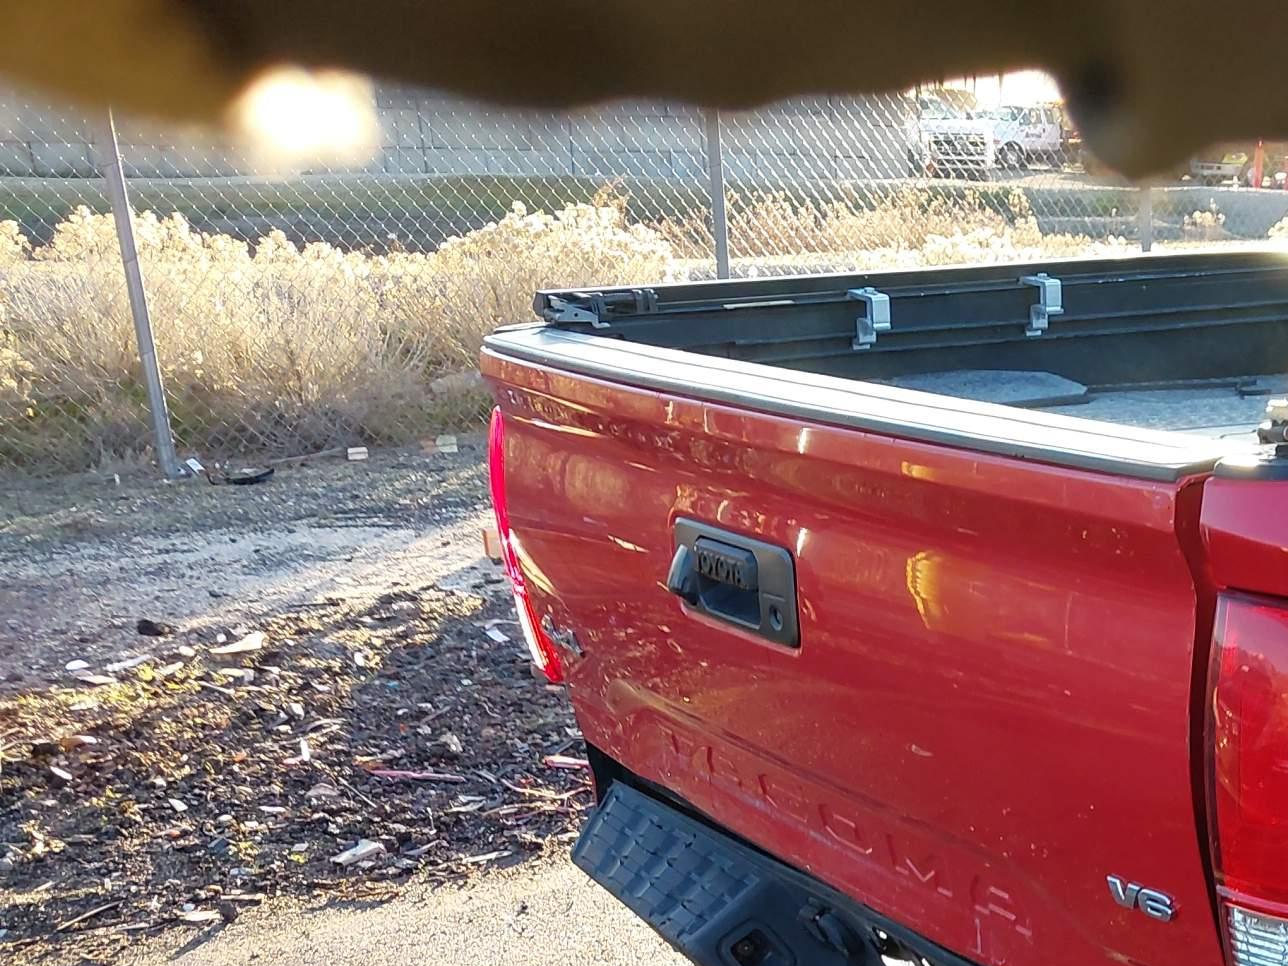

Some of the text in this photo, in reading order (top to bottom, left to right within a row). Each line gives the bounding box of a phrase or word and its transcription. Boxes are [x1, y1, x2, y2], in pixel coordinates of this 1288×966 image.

[695, 551, 747, 591] TOYOTA
[656, 719, 1032, 938] TACOMA
[1106, 875, 1172, 922] V6
